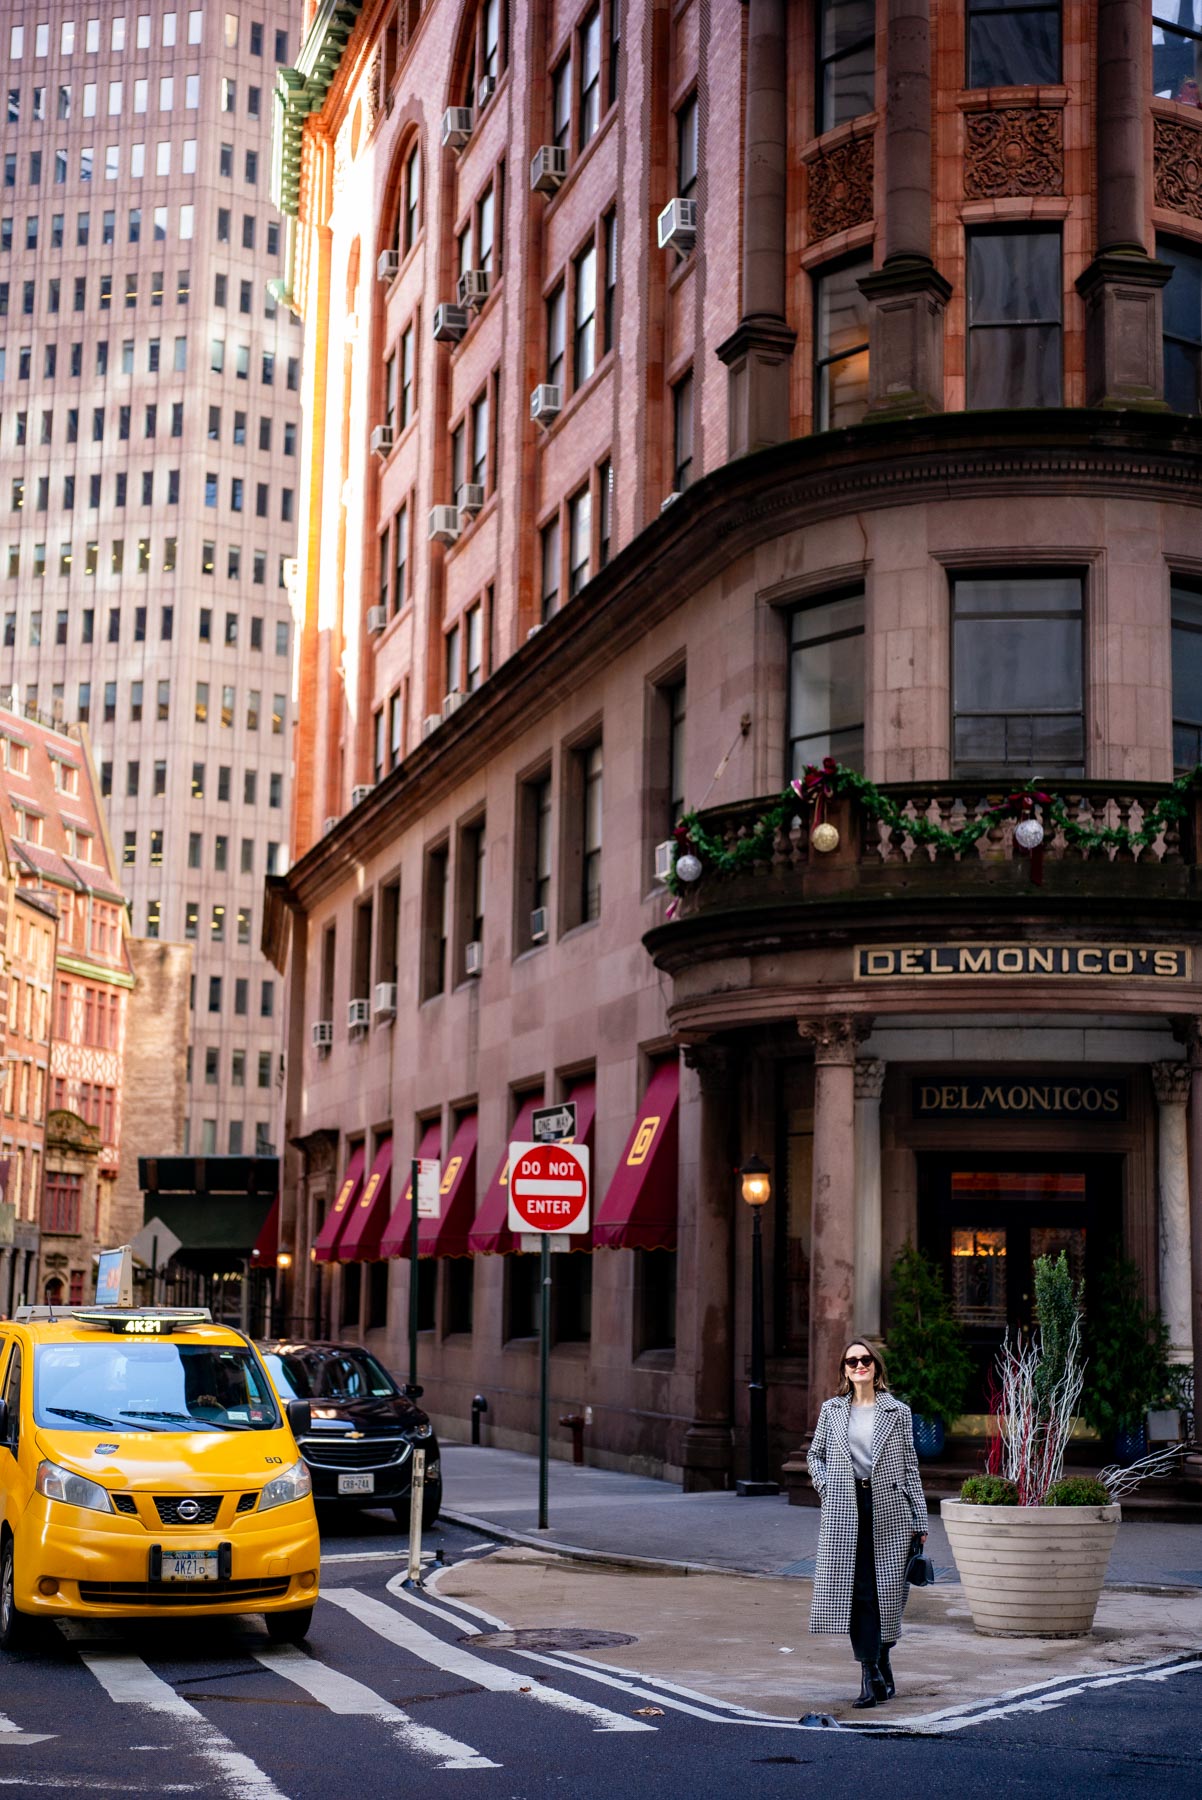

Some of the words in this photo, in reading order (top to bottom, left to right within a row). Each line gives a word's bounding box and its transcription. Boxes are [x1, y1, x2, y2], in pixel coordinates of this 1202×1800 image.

[866, 947, 1179, 976] DELMONICO'S
[919, 1085, 1119, 1113] DELMONICOS
[537, 1118, 551, 1132] ONE
[556, 1115, 570, 1129] WAY
[521, 1160, 541, 1175] DO
[548, 1162, 576, 1176] NOT
[526, 1200, 571, 1214] ENTER
[124, 1320, 161, 1333] 4K21
